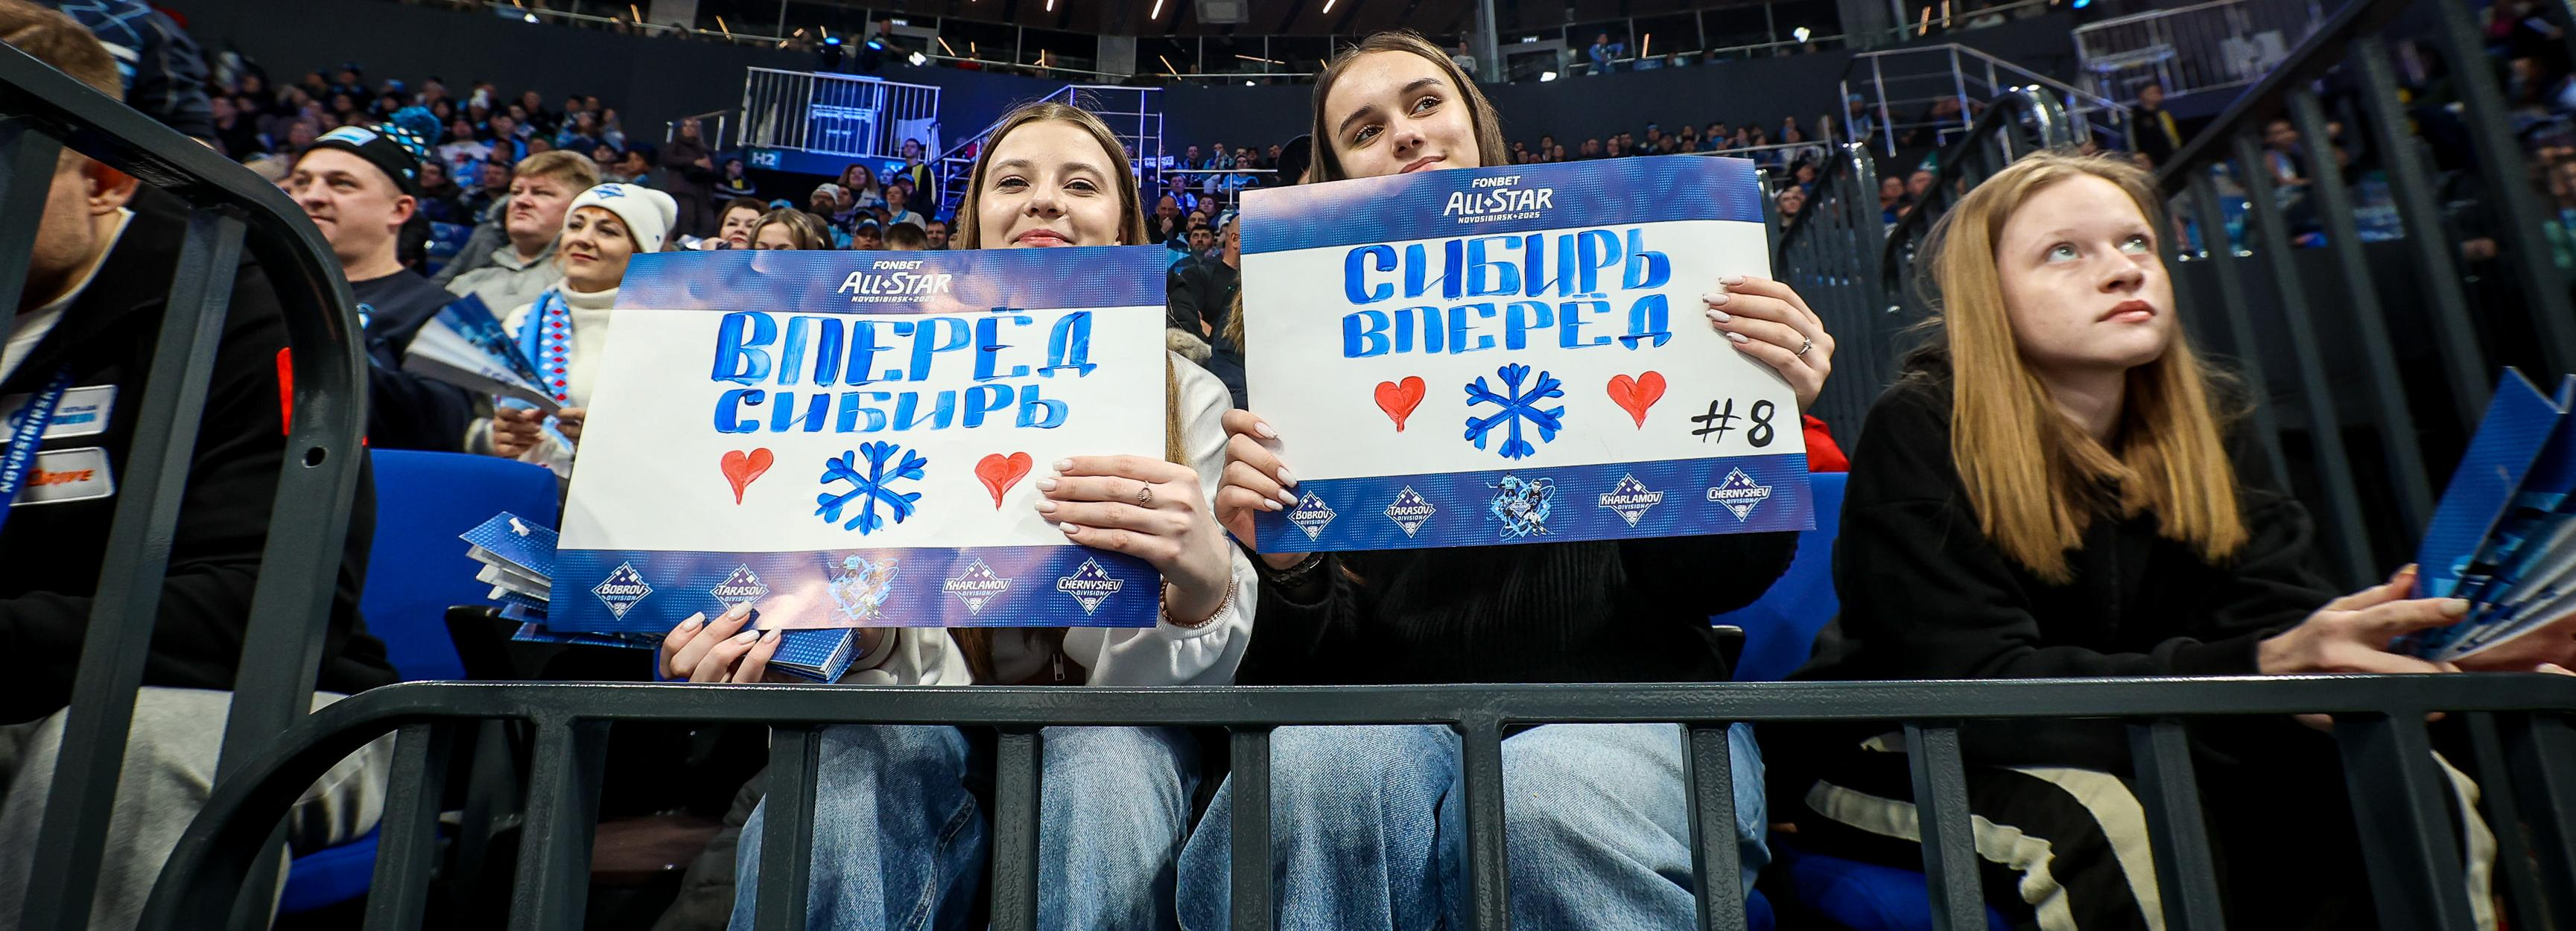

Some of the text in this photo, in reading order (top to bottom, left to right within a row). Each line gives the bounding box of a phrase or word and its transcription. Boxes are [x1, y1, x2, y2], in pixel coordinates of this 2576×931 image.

[752, 152, 775, 165] H2
[1472, 175, 1521, 188] FONBET
[1458, 211, 1541, 223] NOVOSIBIRSK 2025
[872, 260, 923, 270] FONBET
[1344, 228, 1672, 305] СИБИРЬ
[1343, 293, 1672, 358] ВПЕРЁД
[711, 307, 1097, 387] ВПЕРЁД
[714, 384, 1069, 434] СИБИРЬ
[1601, 493, 1660, 505] KHARLAMOV
[1709, 488, 1769, 499] CHERNYSHEV
[1295, 510, 1329, 520] BOBROV
[1389, 505, 1430, 515] TARASOV
[602, 583, 645, 594] BOBROV
[717, 585, 764, 596] TARASOV
[945, 579, 1008, 590] KHARLAMOV
[1059, 579, 1120, 591] CHERNYSHEV
